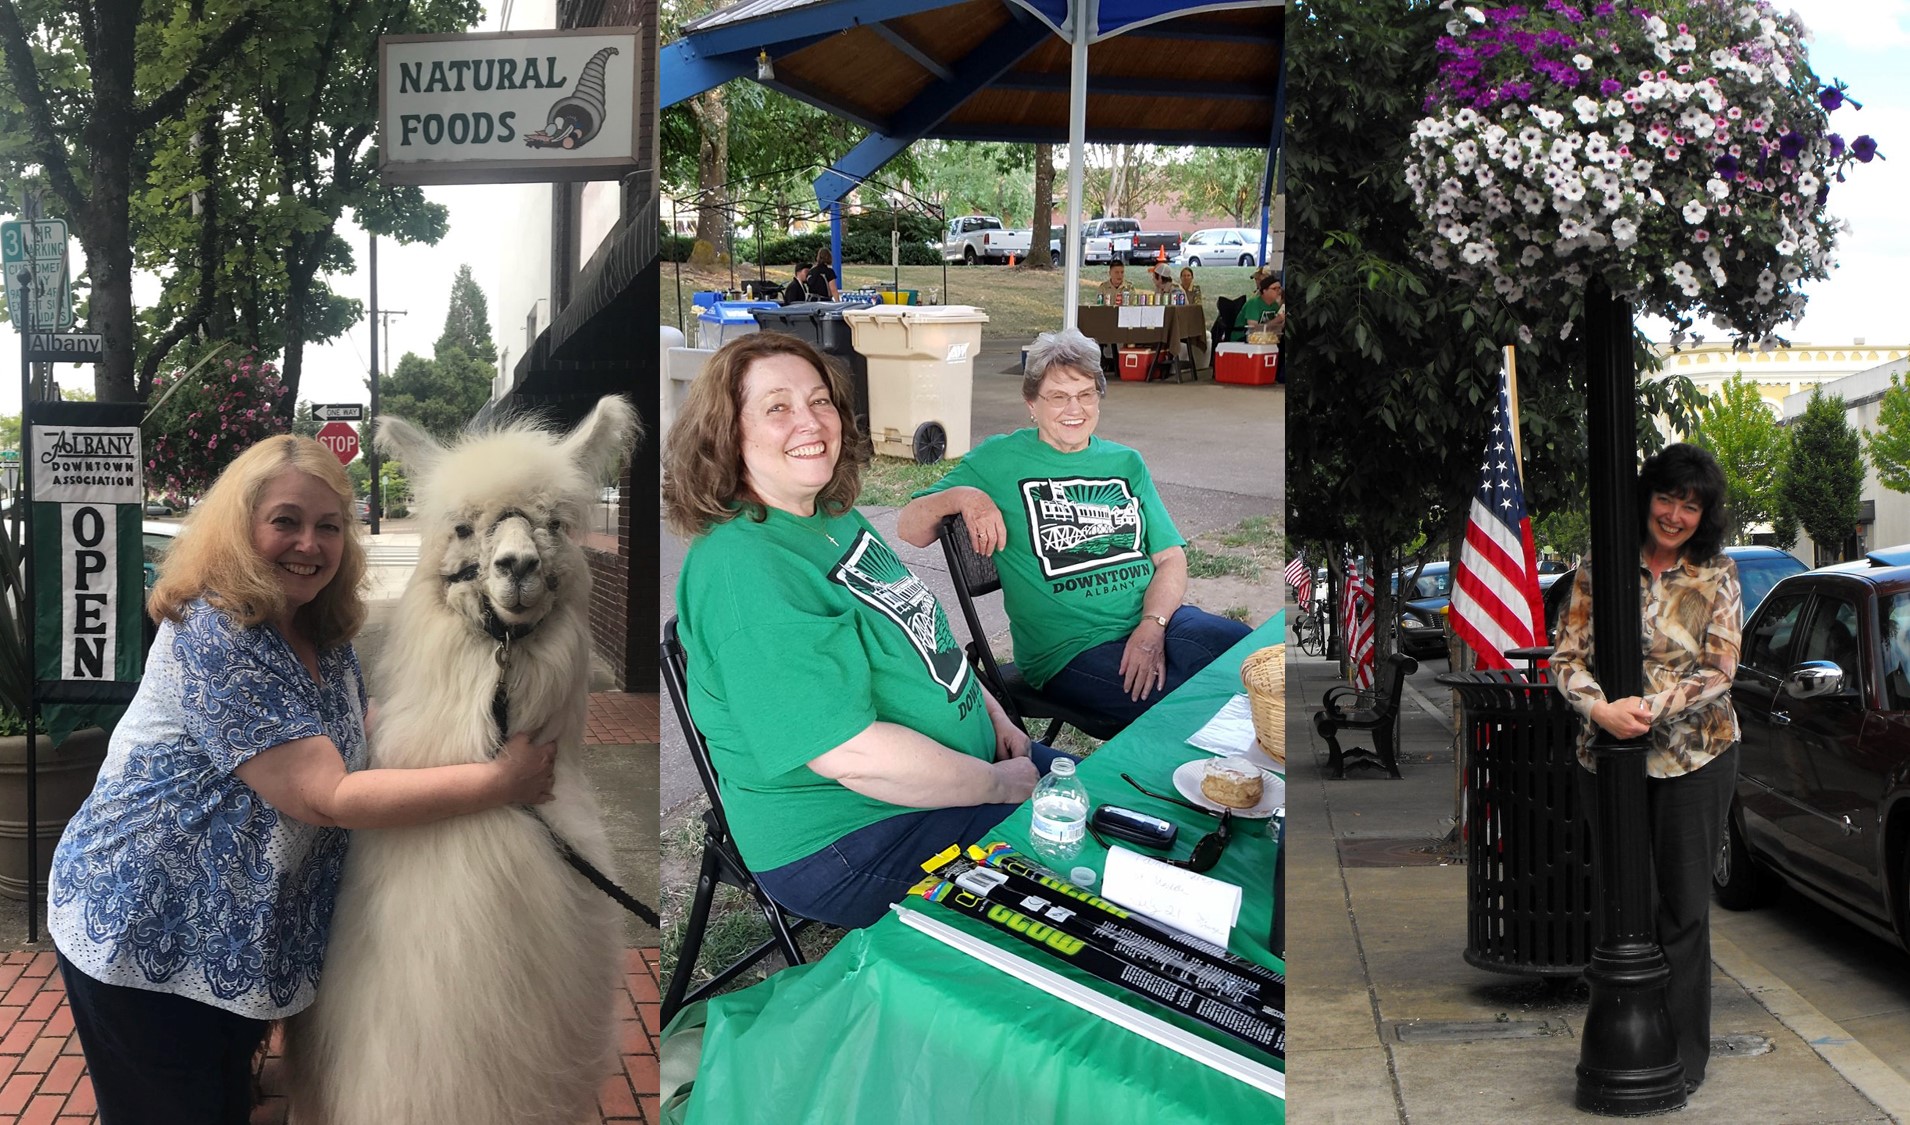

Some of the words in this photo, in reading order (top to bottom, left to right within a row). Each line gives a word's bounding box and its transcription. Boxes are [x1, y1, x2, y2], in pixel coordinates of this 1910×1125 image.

[399, 56, 567, 94] NATURAL
[400, 111, 516, 146] FOODS
[5, 229, 19, 256] 3
[29, 334, 99, 353] Albany
[327, 408, 341, 416] ONE
[343, 408, 358, 416] WAY
[41, 430, 134, 464] ALBANY
[319, 436, 356, 453] STOP
[52, 461, 134, 473] DOWNTOWN
[52, 475, 134, 487] ASSOCIATION
[73, 506, 107, 678] OPEN
[1052, 564, 1150, 594] DOWNTOWN
[1085, 581, 1136, 598] ALBANY
[987, 903, 1086, 956] GLOW
